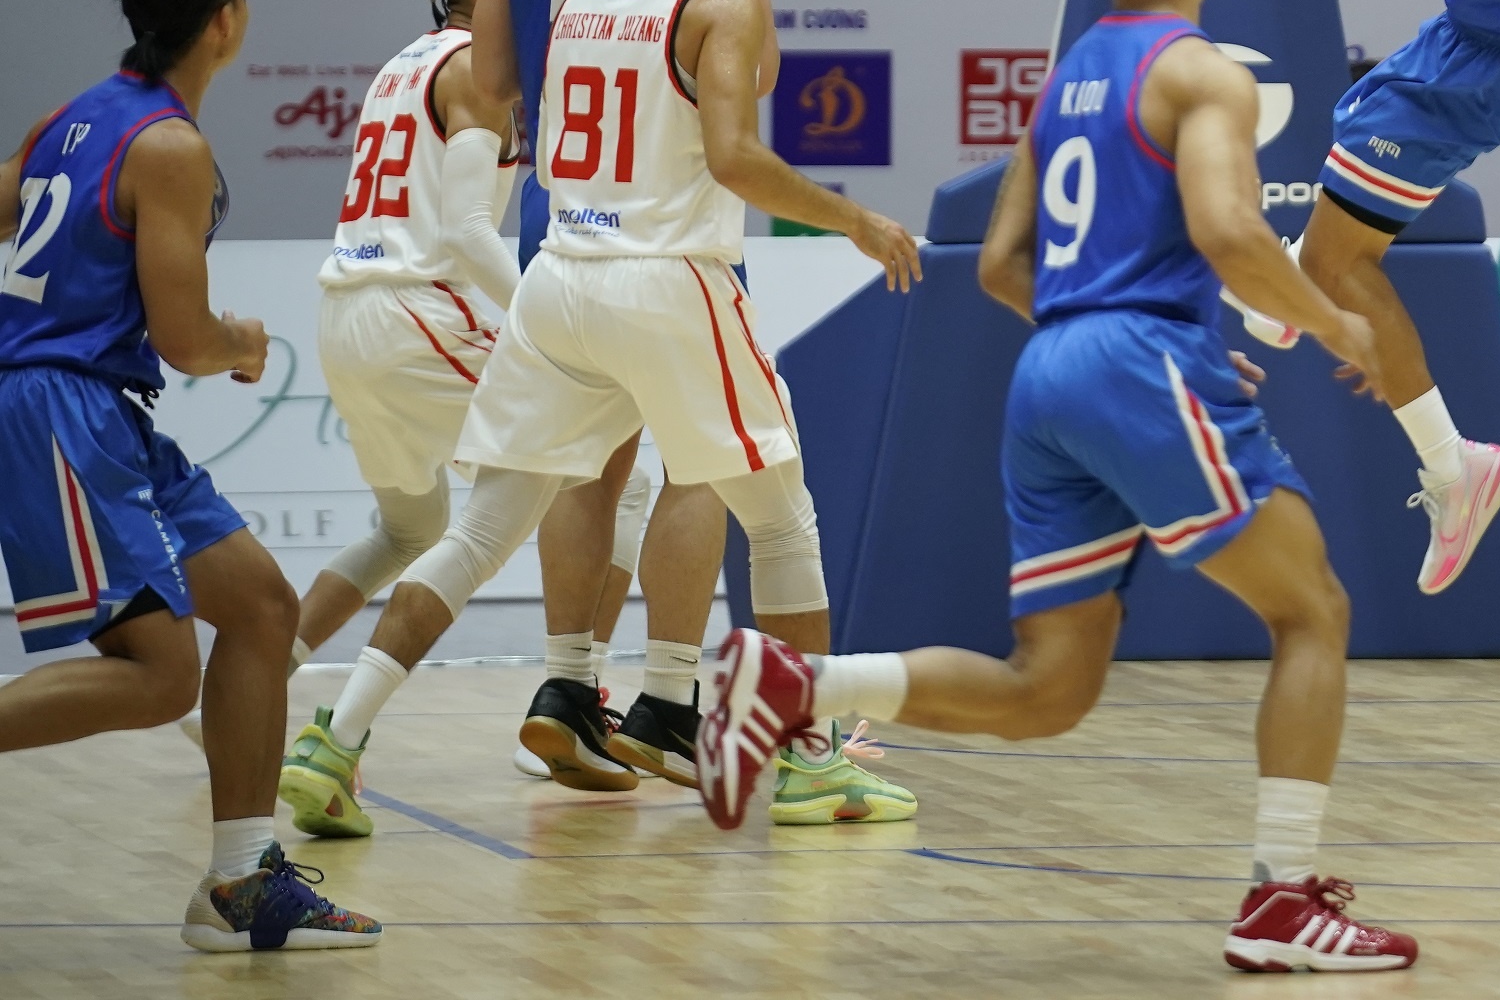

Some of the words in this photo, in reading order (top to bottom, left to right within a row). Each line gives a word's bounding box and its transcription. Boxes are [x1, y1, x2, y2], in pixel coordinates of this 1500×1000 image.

[555, 12, 617, 41] CHRISTIAN
[618, 14, 665, 43] JUZANG
[550, 65, 639, 183] 81
[338, 112, 418, 224] 32
[1042, 135, 1097, 270] 9
[557, 207, 620, 228] molten
[236, 509, 335, 537] OLF
